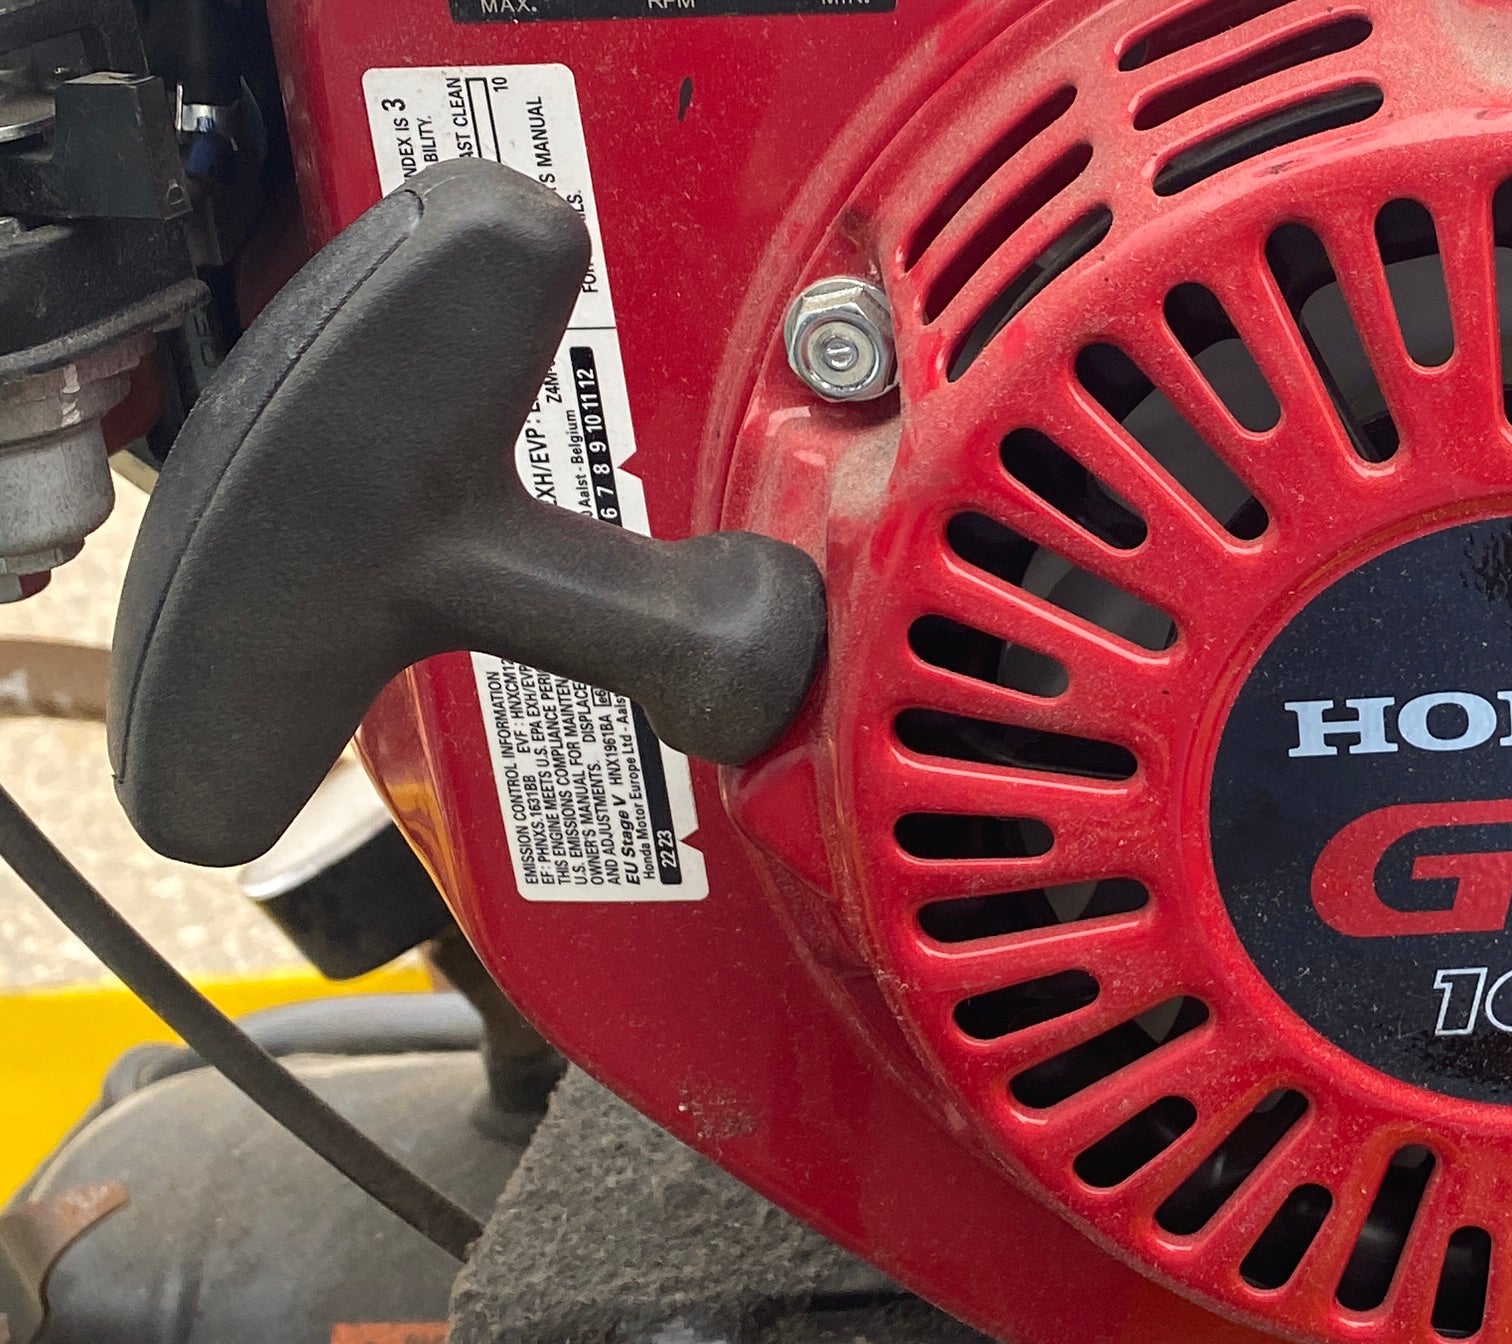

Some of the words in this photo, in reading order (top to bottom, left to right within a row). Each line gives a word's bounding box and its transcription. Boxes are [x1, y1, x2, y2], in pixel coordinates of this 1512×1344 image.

[491, 76, 508, 92] 10
[381, 98, 405, 111] 3
[445, 77, 468, 126] CLEAN
[393, 117, 409, 130] IS
[526, 96, 552, 166] MANUAL
[576, 368, 594, 387] 12
[580, 394, 598, 409] 11
[565, 409, 584, 463] Belgium
[584, 414, 602, 432] 10
[588, 441, 606, 452] 9
[592, 463, 610, 474] 8
[575, 474, 591, 507] Aalst
[596, 486, 613, 496] 7
[600, 507, 617, 518] 6
[486, 671, 514, 758] INFORMATION
[528, 720, 545, 741] EPA
[619, 734, 639, 753] Ltd
[543, 704, 570, 785] COMPLIANCE
[566, 741, 583, 765] FOR
[503, 762, 526, 820] CONTROL
[537, 770, 557, 809] MEETS
[626, 757, 642, 799] Europe
[571, 770, 593, 824] MANUAL
[611, 794, 626, 805] V
[558, 790, 583, 857] EMISSIONS
[618, 810, 635, 857] Stage
[632, 802, 648, 839] Motor
[545, 813, 566, 856] ENGINE
[656, 830, 673, 847] 23
[515, 825, 538, 884] EMISSION
[581, 828, 604, 885] OWNER'S
[638, 842, 655, 879] Honda
[659, 850, 676, 867] 22
[554, 859, 570, 885] THIS
[604, 859, 621, 885] AND
[623, 861, 640, 885] EU
